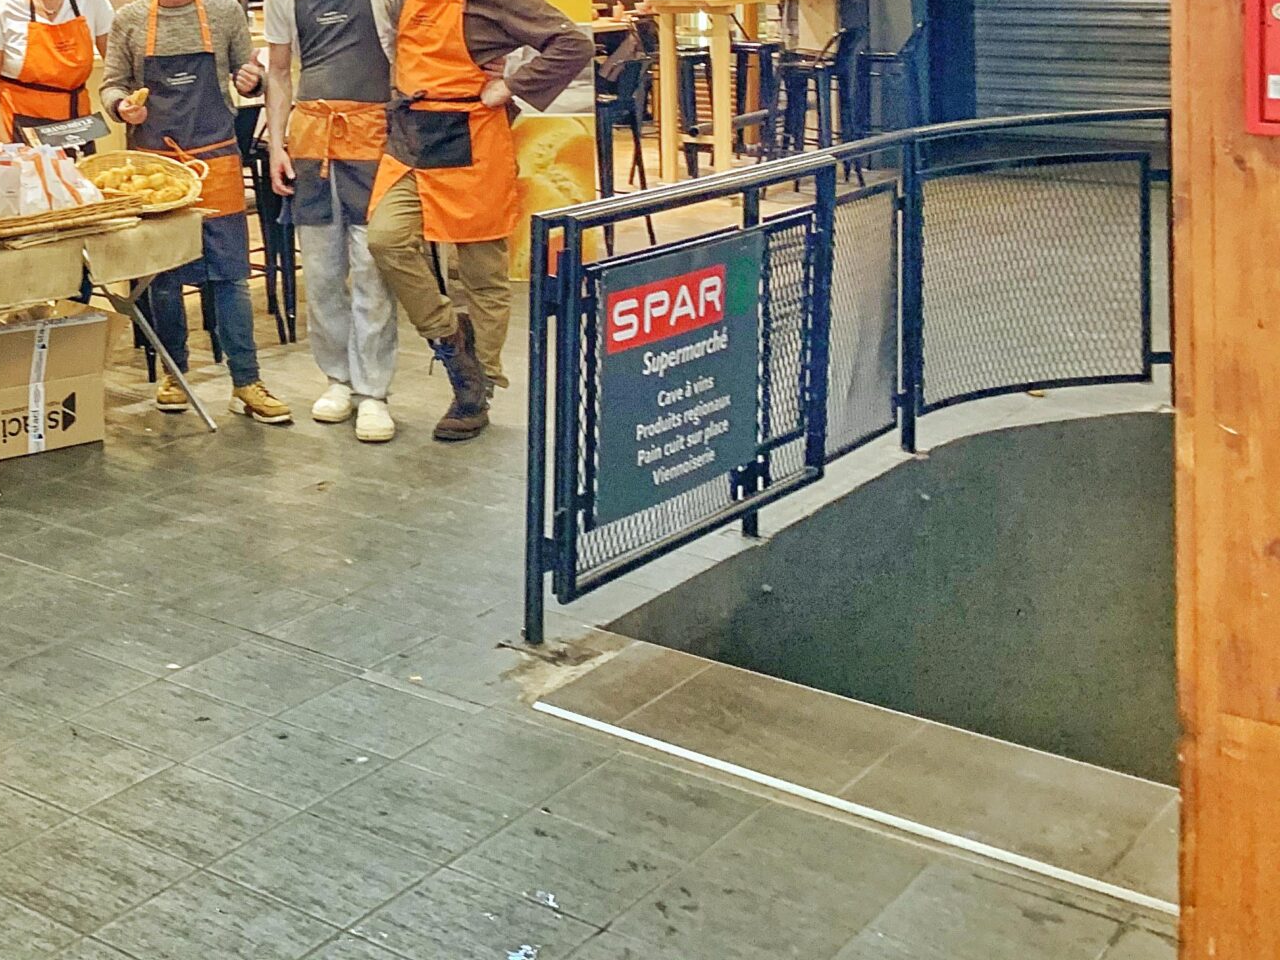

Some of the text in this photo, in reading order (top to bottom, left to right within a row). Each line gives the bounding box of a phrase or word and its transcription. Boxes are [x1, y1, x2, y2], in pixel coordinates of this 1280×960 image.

[612, 276, 722, 342] SPAR
[642, 325, 729, 378] Supermarché
[657, 388, 684, 407] Cave
[684, 380, 692, 398] à
[1, 410, 60, 444] saci
[636, 411, 682, 441] Produits
[637, 419, 729, 467] Pain cuit sur place
